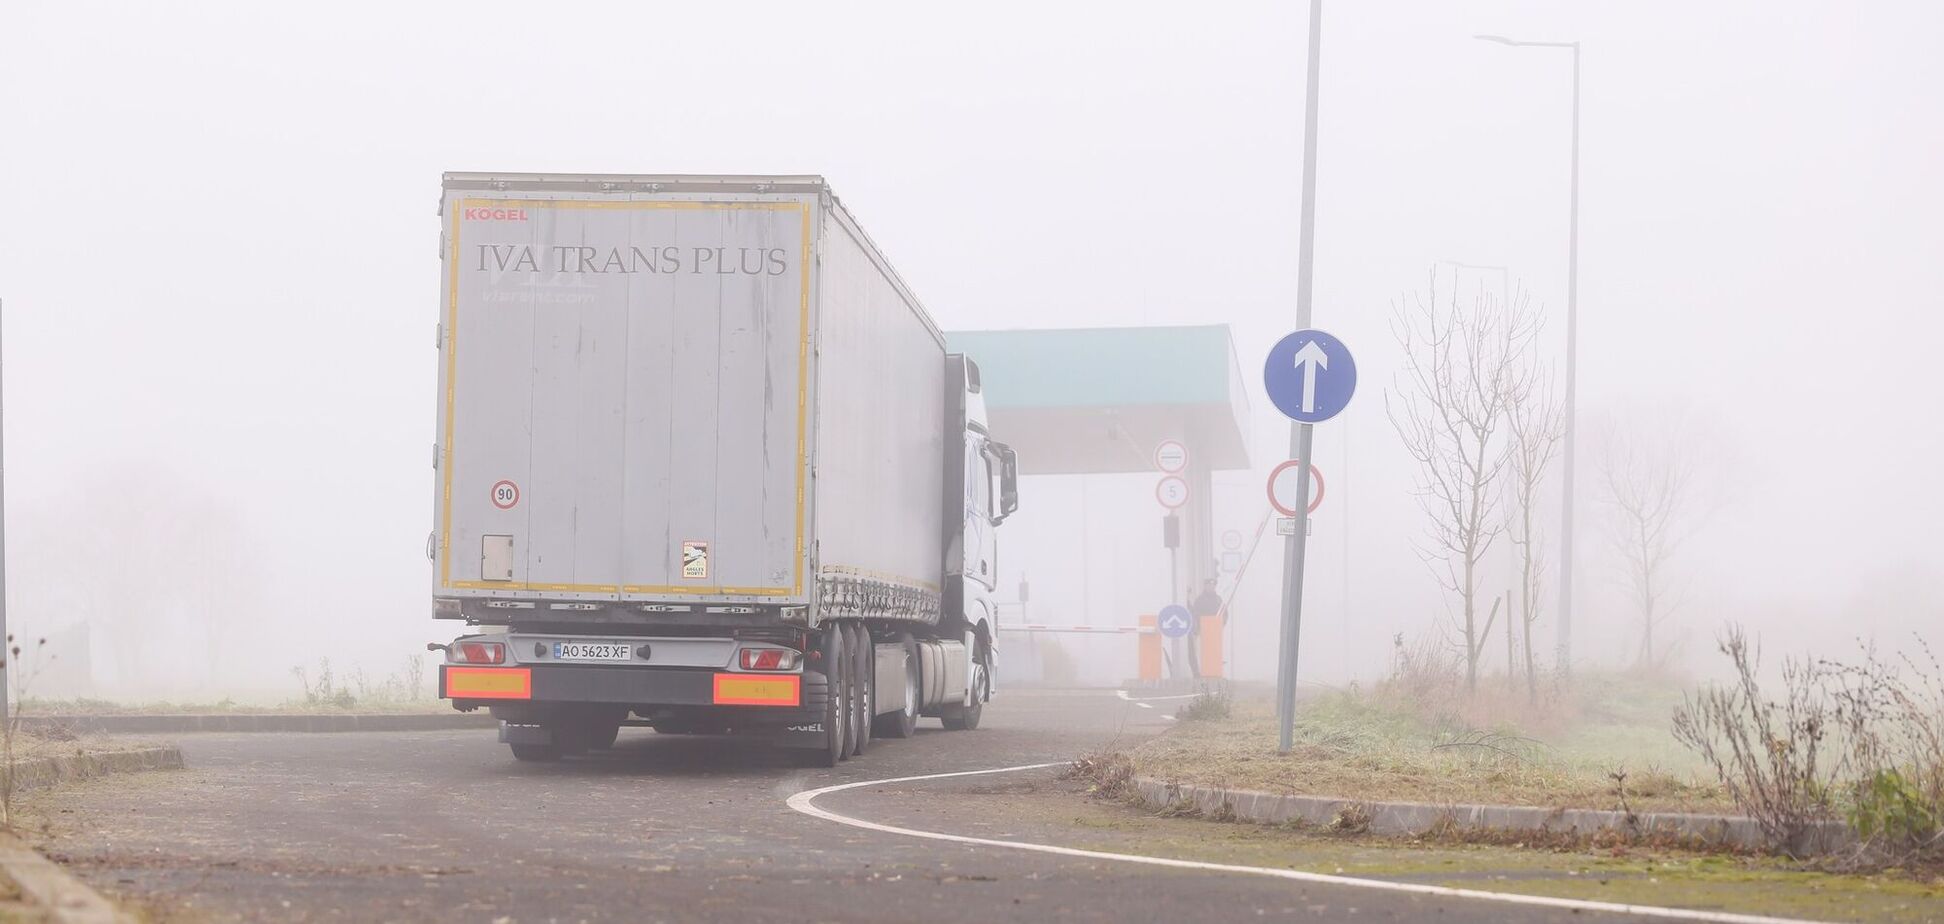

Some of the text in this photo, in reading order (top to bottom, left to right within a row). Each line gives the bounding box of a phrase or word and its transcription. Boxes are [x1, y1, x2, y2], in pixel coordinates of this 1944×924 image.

[477, 245, 787, 275] IVA TRANS PLUS
[498, 488, 513, 500] 90
[1168, 485, 1177, 498] 5
[582, 645, 610, 658] 5623
[612, 646, 629, 658] XF
